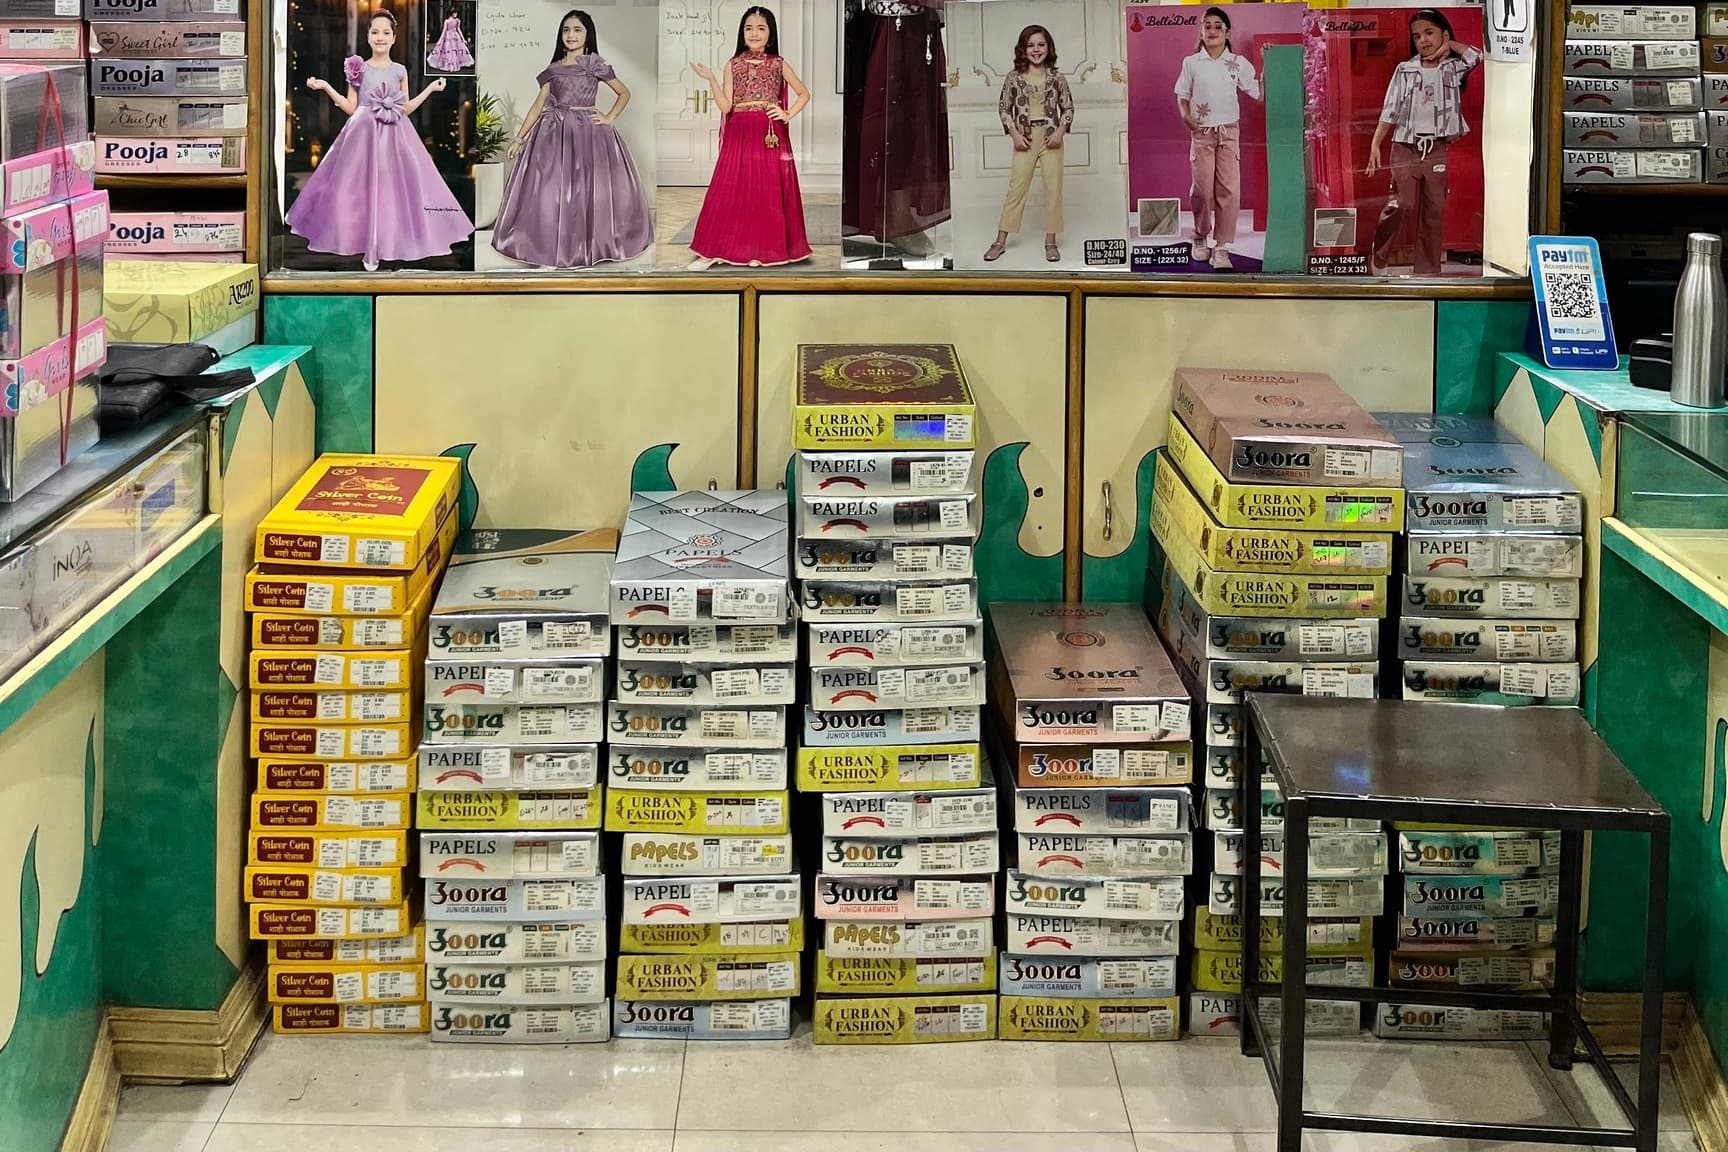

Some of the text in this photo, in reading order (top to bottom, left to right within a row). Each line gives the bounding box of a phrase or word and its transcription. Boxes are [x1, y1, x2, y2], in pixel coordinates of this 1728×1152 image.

[121, 37, 150, 50] Sweet
[100, 65, 165, 88] Pooja
[1565, 80, 1619, 92] PAPELS
[1572, 116, 1625, 128] PAPELS
[105, 142, 169, 164] Pooja
[1087, 241, 1124, 250] D.NO-230
[1134, 257, 1152, 265] SIZE
[819, 414, 869, 425] URBAN
[815, 425, 874, 437] FASHION
[811, 459, 876, 473] PAPELS
[367, 492, 403, 501] Coin
[1252, 494, 1301, 505] URBAN
[694, 507, 759, 515] CREATION
[812, 502, 878, 516] PAPELS
[1247, 506, 1307, 517] FASHION
[269, 536, 318, 549] Silver Coin
[1241, 537, 1290, 549] URBAN
[1235, 550, 1294, 561] FASHION
[1234, 582, 1284, 592] URBAN
[1230, 593, 1288, 604] FASHION
[262, 661, 312, 672] Silver Coin
[824, 756, 874, 767] URBAN
[819, 767, 879, 779] FASHION
[632, 797, 681, 808] URBAN
[1025, 796, 1091, 810] PAPELS
[264, 804, 313, 814] Silver Coin
[626, 809, 687, 821] FASHION
[429, 840, 496, 855] PAPELS
[841, 1008, 890, 1018] URBAN
[1025, 1005, 1076, 1016] URBAN
[836, 1020, 895, 1032] FASHION
[1020, 1017, 1079, 1028] FASHION
